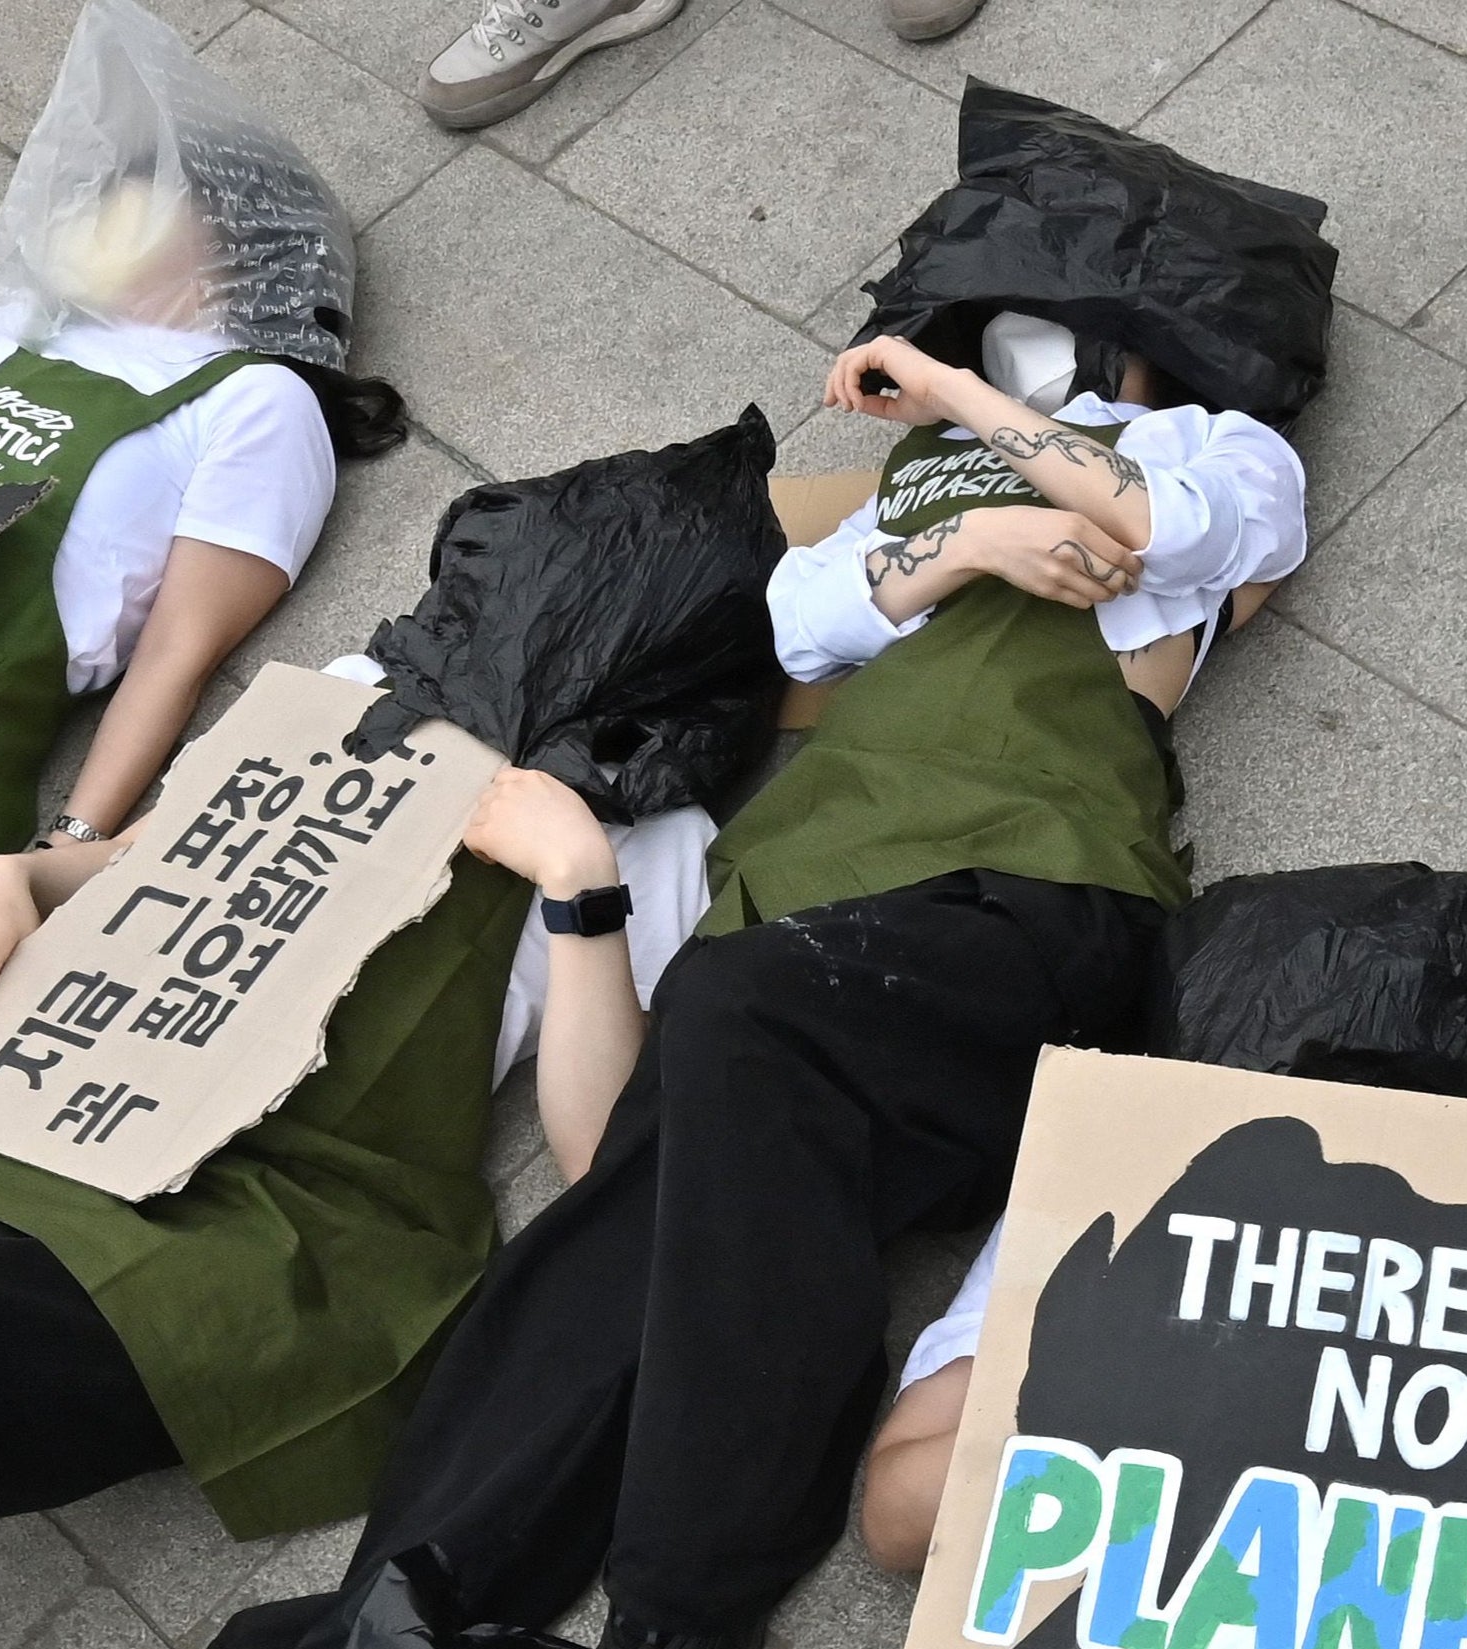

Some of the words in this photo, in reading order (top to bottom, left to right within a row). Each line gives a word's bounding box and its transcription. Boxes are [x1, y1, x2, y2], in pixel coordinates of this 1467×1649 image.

[891, 456, 942, 487] GO
[876, 486, 916, 522] NO
[101, 885, 212, 955] 그
[162, 752, 333, 883] 포장,
[45, 1081, 160, 1146] 꼭
